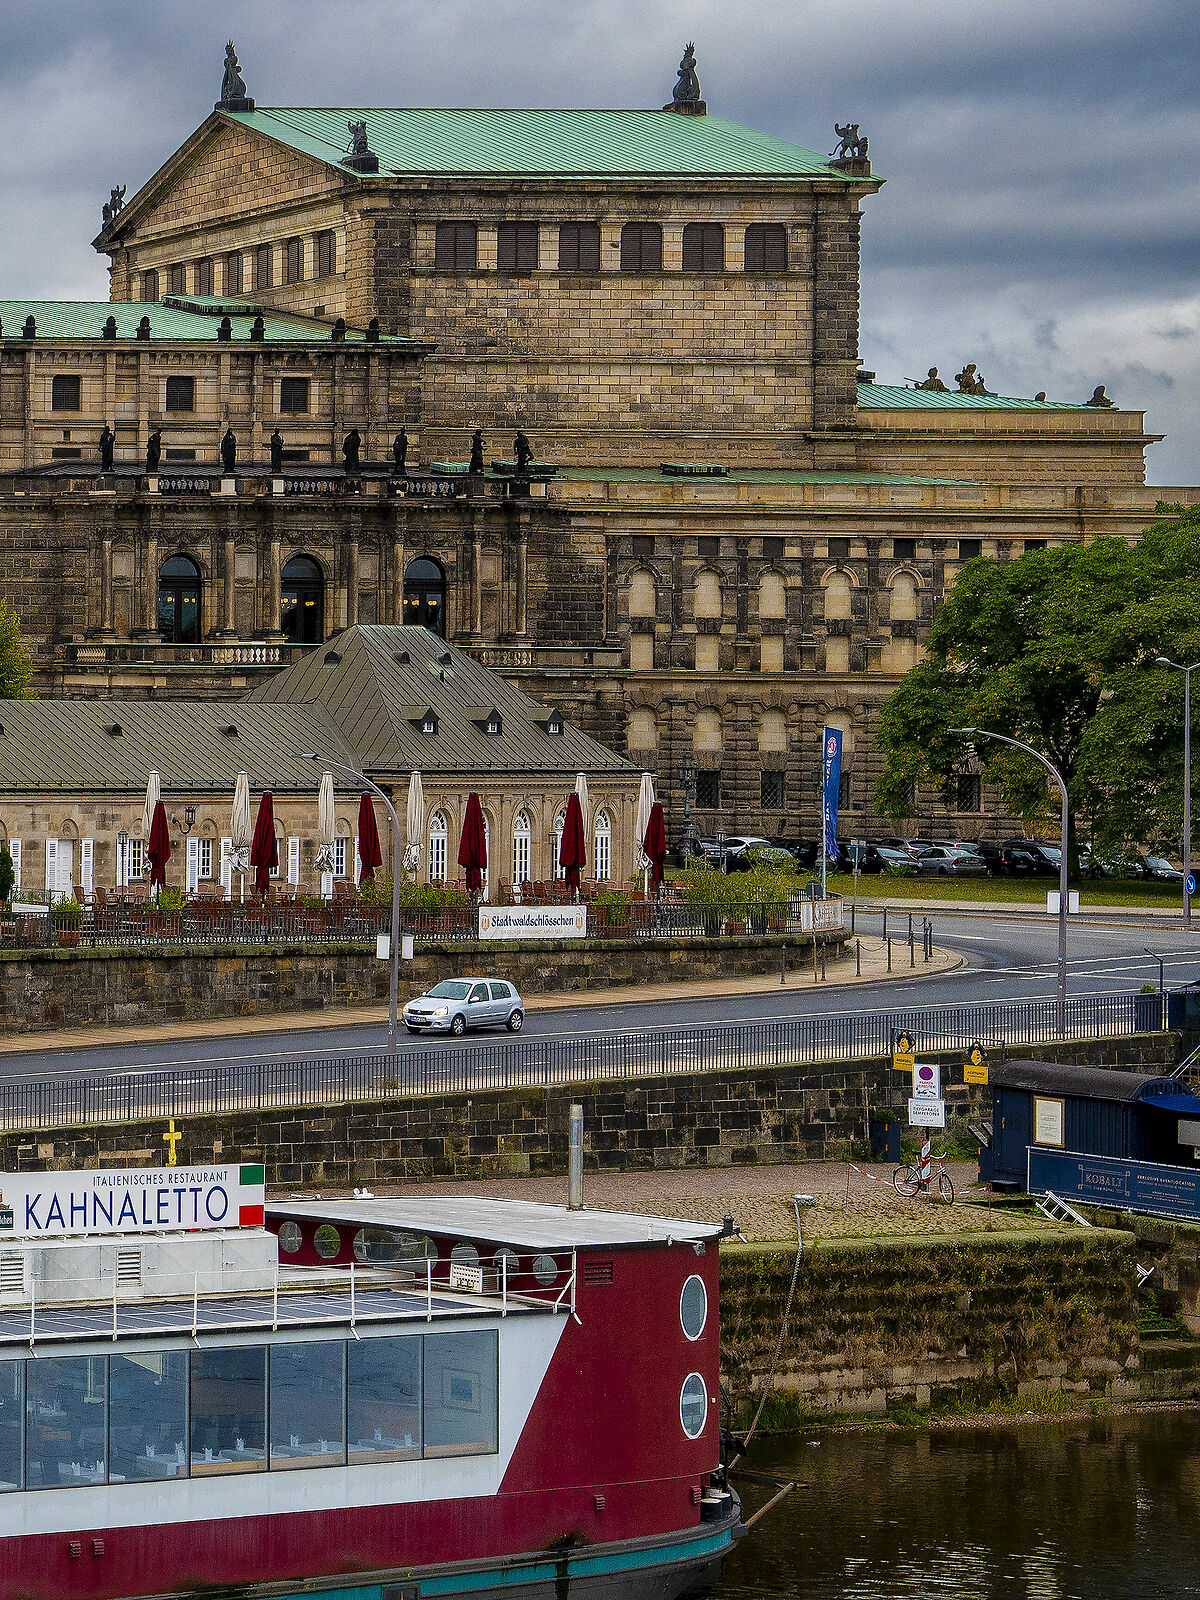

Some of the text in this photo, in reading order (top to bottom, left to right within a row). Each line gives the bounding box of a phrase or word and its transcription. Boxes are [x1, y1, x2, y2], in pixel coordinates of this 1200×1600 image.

[491, 914, 574, 927] Stadtwaldschlösschen
[93, 1170, 228, 1187] ITALIENISCHES RESTAURANT
[1085, 1173, 1123, 1188] KOBALT
[25, 1185, 228, 1230] KAHNALETTO
